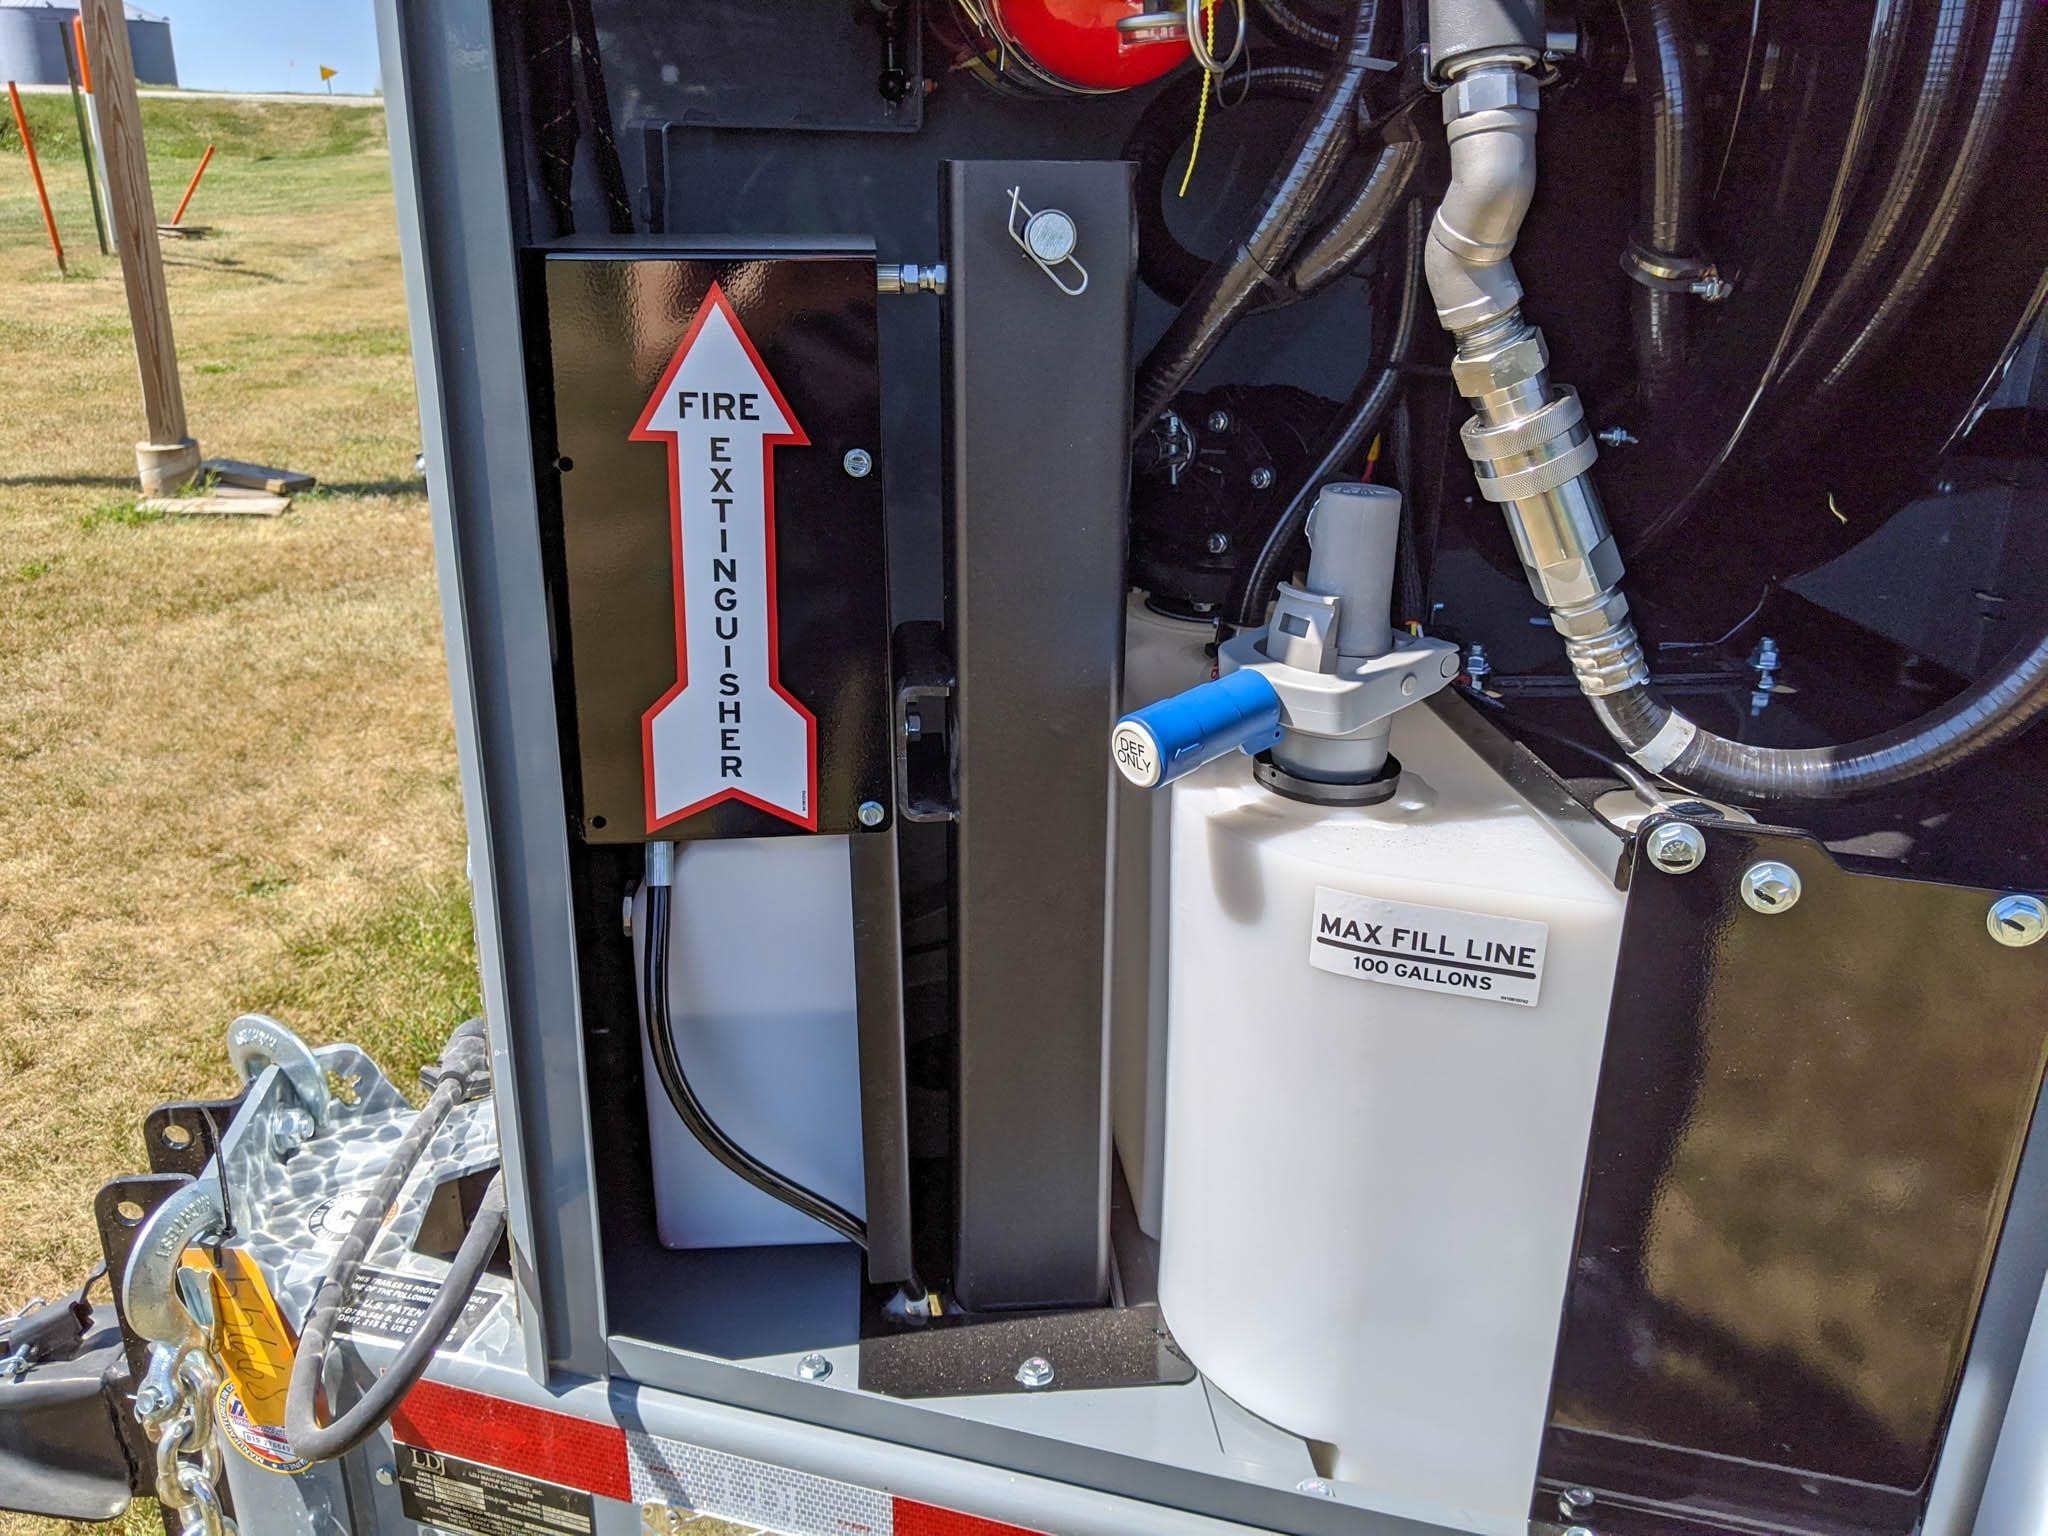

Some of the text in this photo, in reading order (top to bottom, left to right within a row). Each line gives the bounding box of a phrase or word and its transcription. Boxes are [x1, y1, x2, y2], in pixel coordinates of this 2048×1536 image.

[679, 392, 760, 420] FIRE
[710, 437, 742, 777] EXTINGUISHER
[1120, 737, 1144, 757] DEF
[1118, 750, 1151, 773] ONLY
[1320, 913, 1536, 969] MAX FILL LINE
[1353, 956, 1492, 991] 100 GALLONS
[362, 1300, 384, 1310] U.S.
[410, 1448, 446, 1476] LDJ
